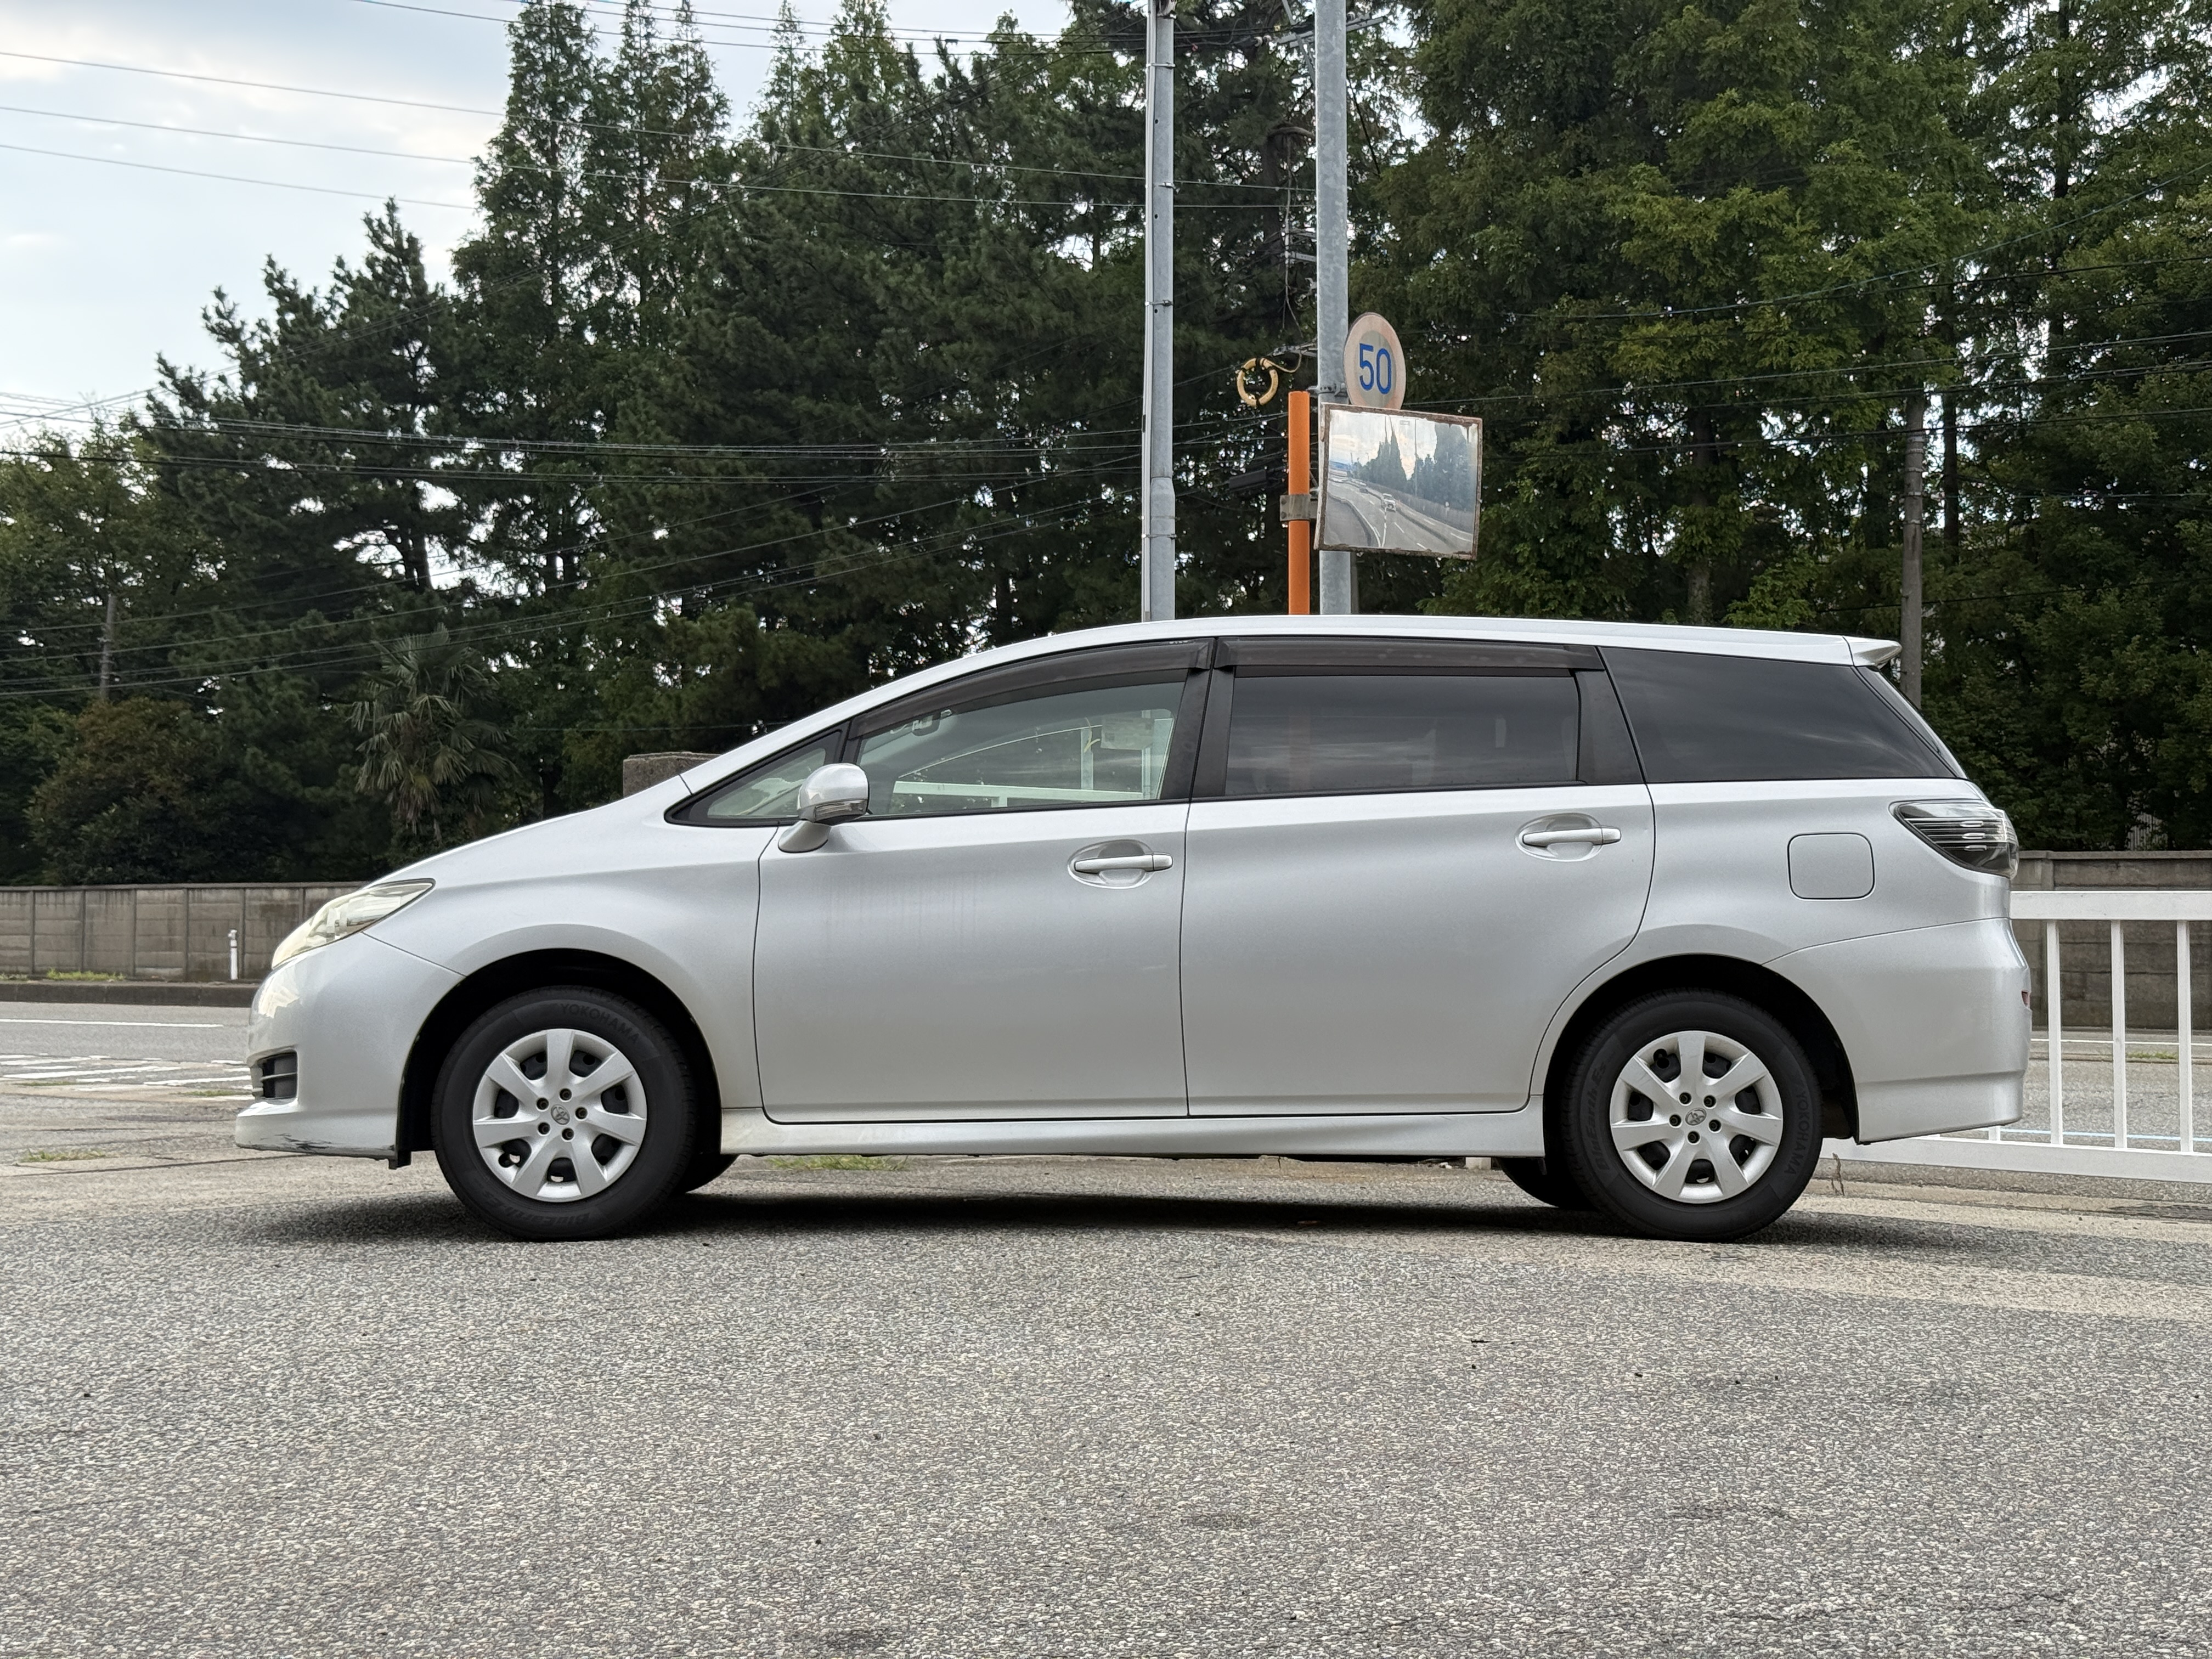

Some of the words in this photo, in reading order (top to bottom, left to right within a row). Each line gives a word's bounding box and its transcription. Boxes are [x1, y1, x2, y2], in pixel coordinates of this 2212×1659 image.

[1359, 342, 1392, 394] 50
[560, 1003, 640, 1045] YOKOHAMA
[1784, 1090, 1810, 1175] YOKOHAMA
